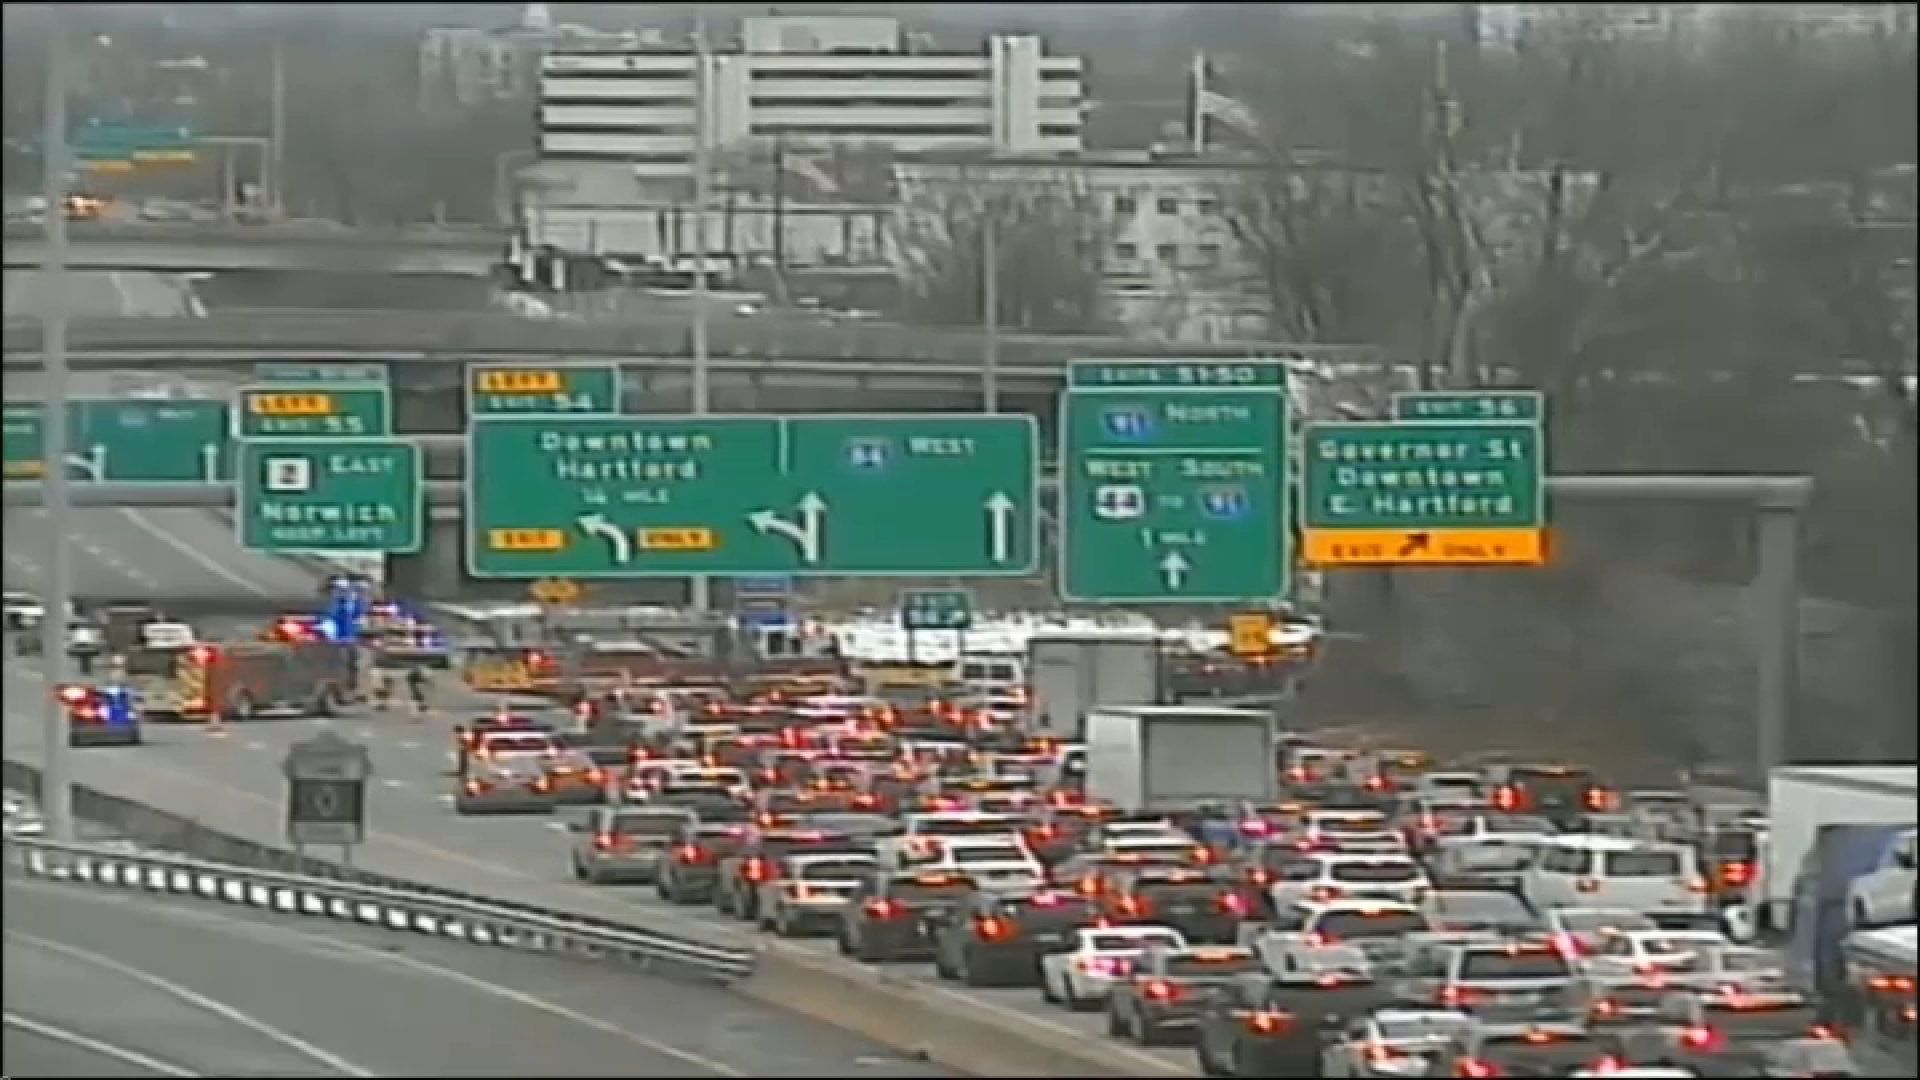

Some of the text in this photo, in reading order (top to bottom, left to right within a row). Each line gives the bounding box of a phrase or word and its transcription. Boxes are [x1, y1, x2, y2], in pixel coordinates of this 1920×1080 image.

[487, 373, 551, 390] LEFT
[553, 392, 593, 409] 54
[1165, 402, 1250, 421] NORTH
[540, 432, 711, 451] Downtown
[908, 436, 975, 455] WEST
[1317, 438, 1523, 460] Governor St
[330, 455, 392, 473] EAST
[555, 459, 697, 479] Hartford
[1086, 459, 1152, 478] WEST
[1336, 466, 1505, 486] Downtown
[261, 502, 396, 523] Norwich
[1372, 494, 1513, 514] Hartford
